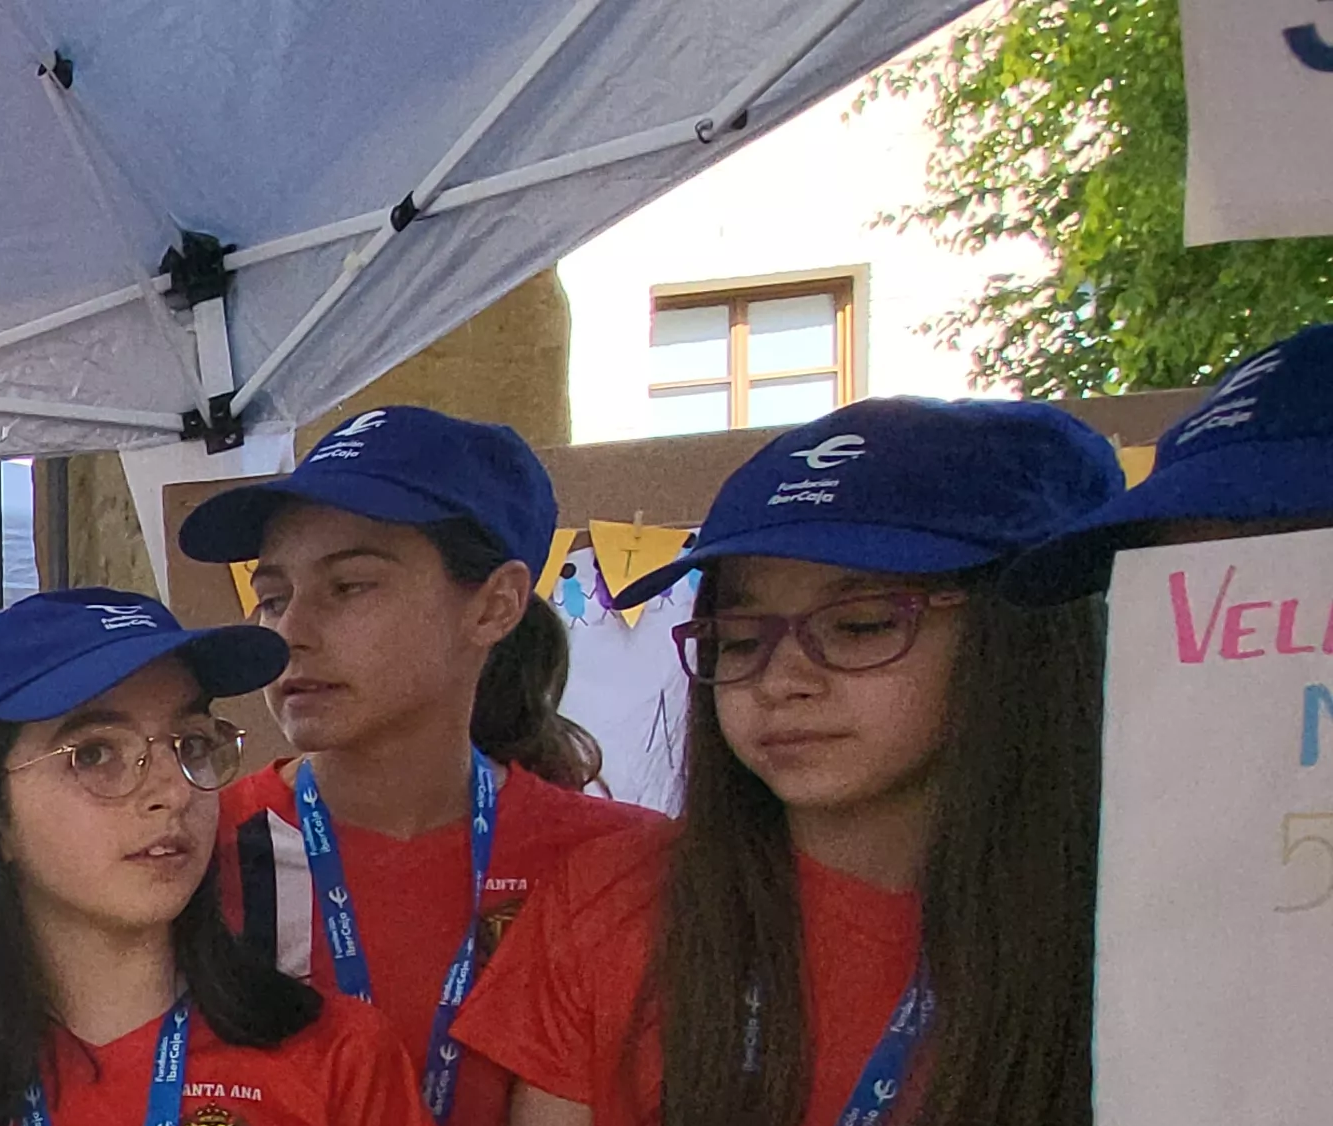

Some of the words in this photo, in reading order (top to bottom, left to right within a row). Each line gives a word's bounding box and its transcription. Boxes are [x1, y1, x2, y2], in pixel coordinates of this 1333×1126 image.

[1168, 564, 1333, 664] VEL
[485, 878, 528, 891] ANTA
[182, 1083, 226, 1097] ANTA
[230, 1085, 262, 1101] ANA
